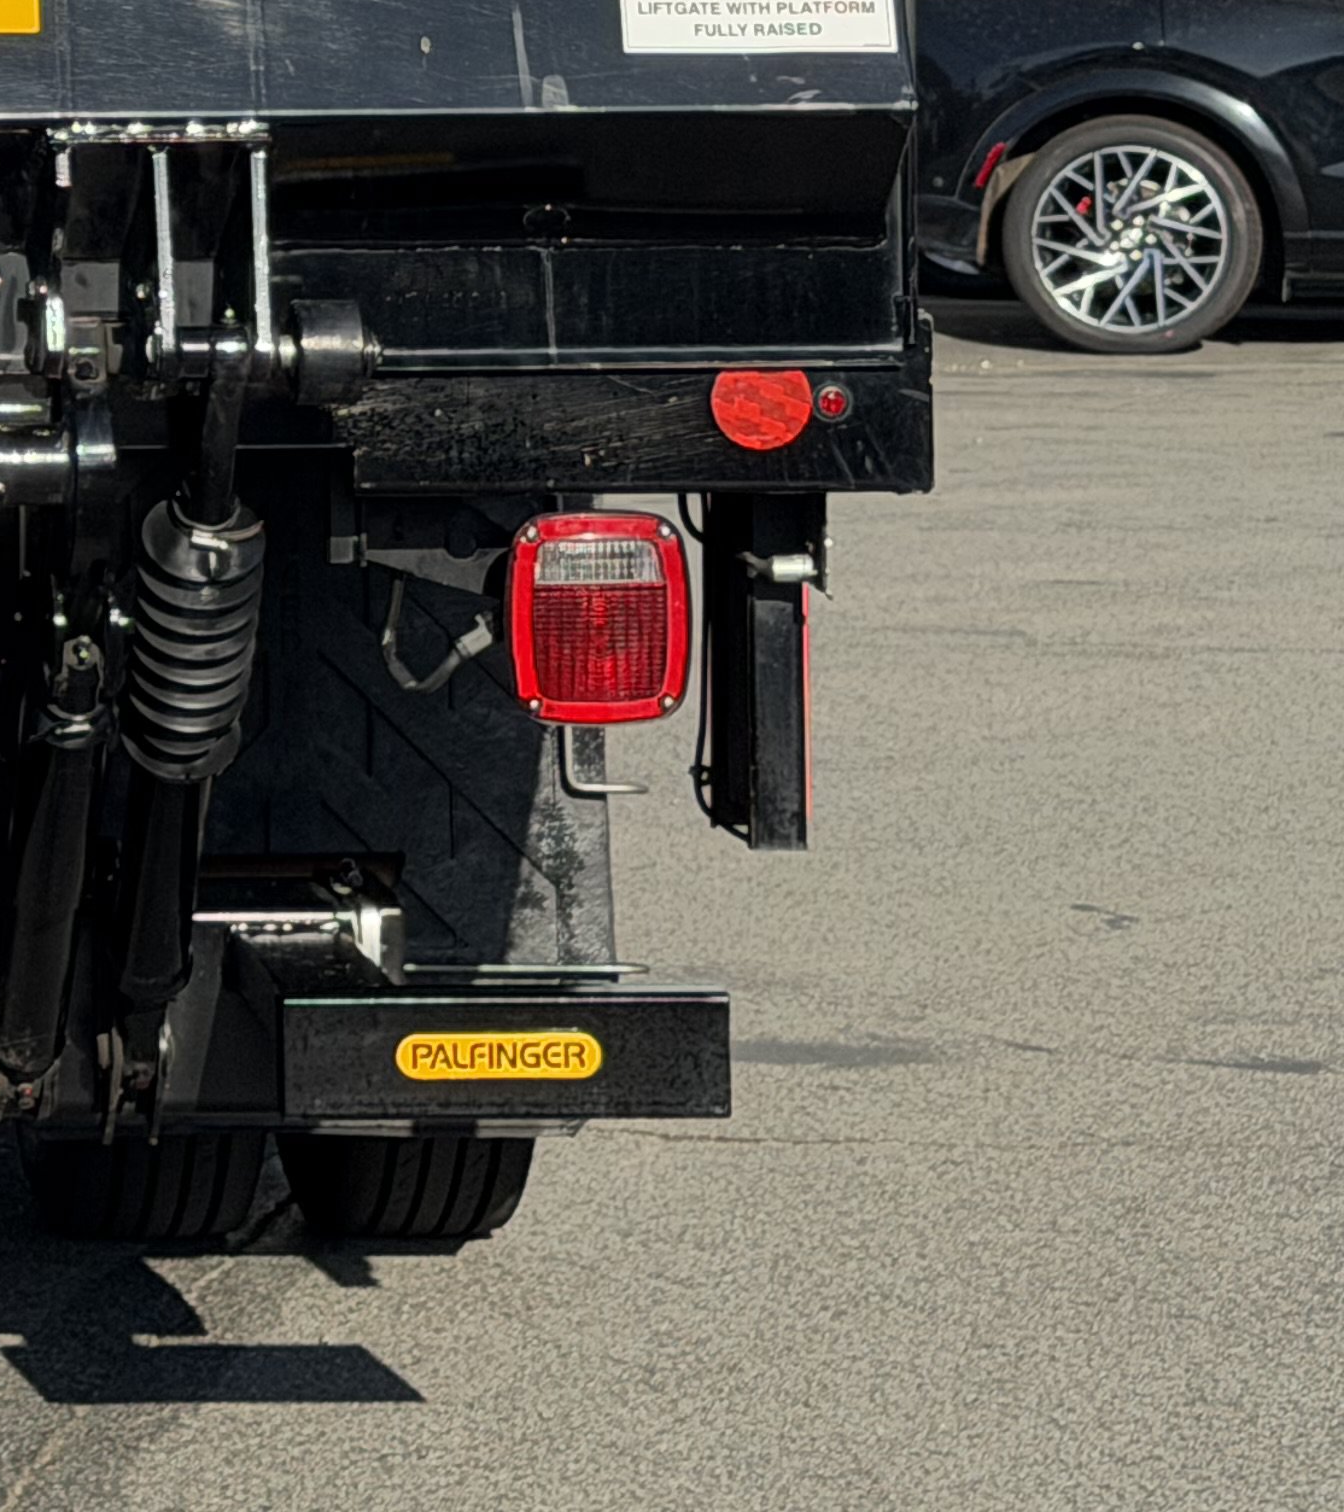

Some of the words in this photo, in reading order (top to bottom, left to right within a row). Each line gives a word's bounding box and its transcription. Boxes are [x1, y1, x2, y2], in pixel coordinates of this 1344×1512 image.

[637, 1, 721, 15] LIFTGATE
[726, 1, 771, 15] WITH
[776, 0, 876, 14] PLATFORM
[694, 24, 748, 37] FULLY
[753, 22, 823, 37] RAISED
[411, 1041, 586, 1070] PALFINGER
